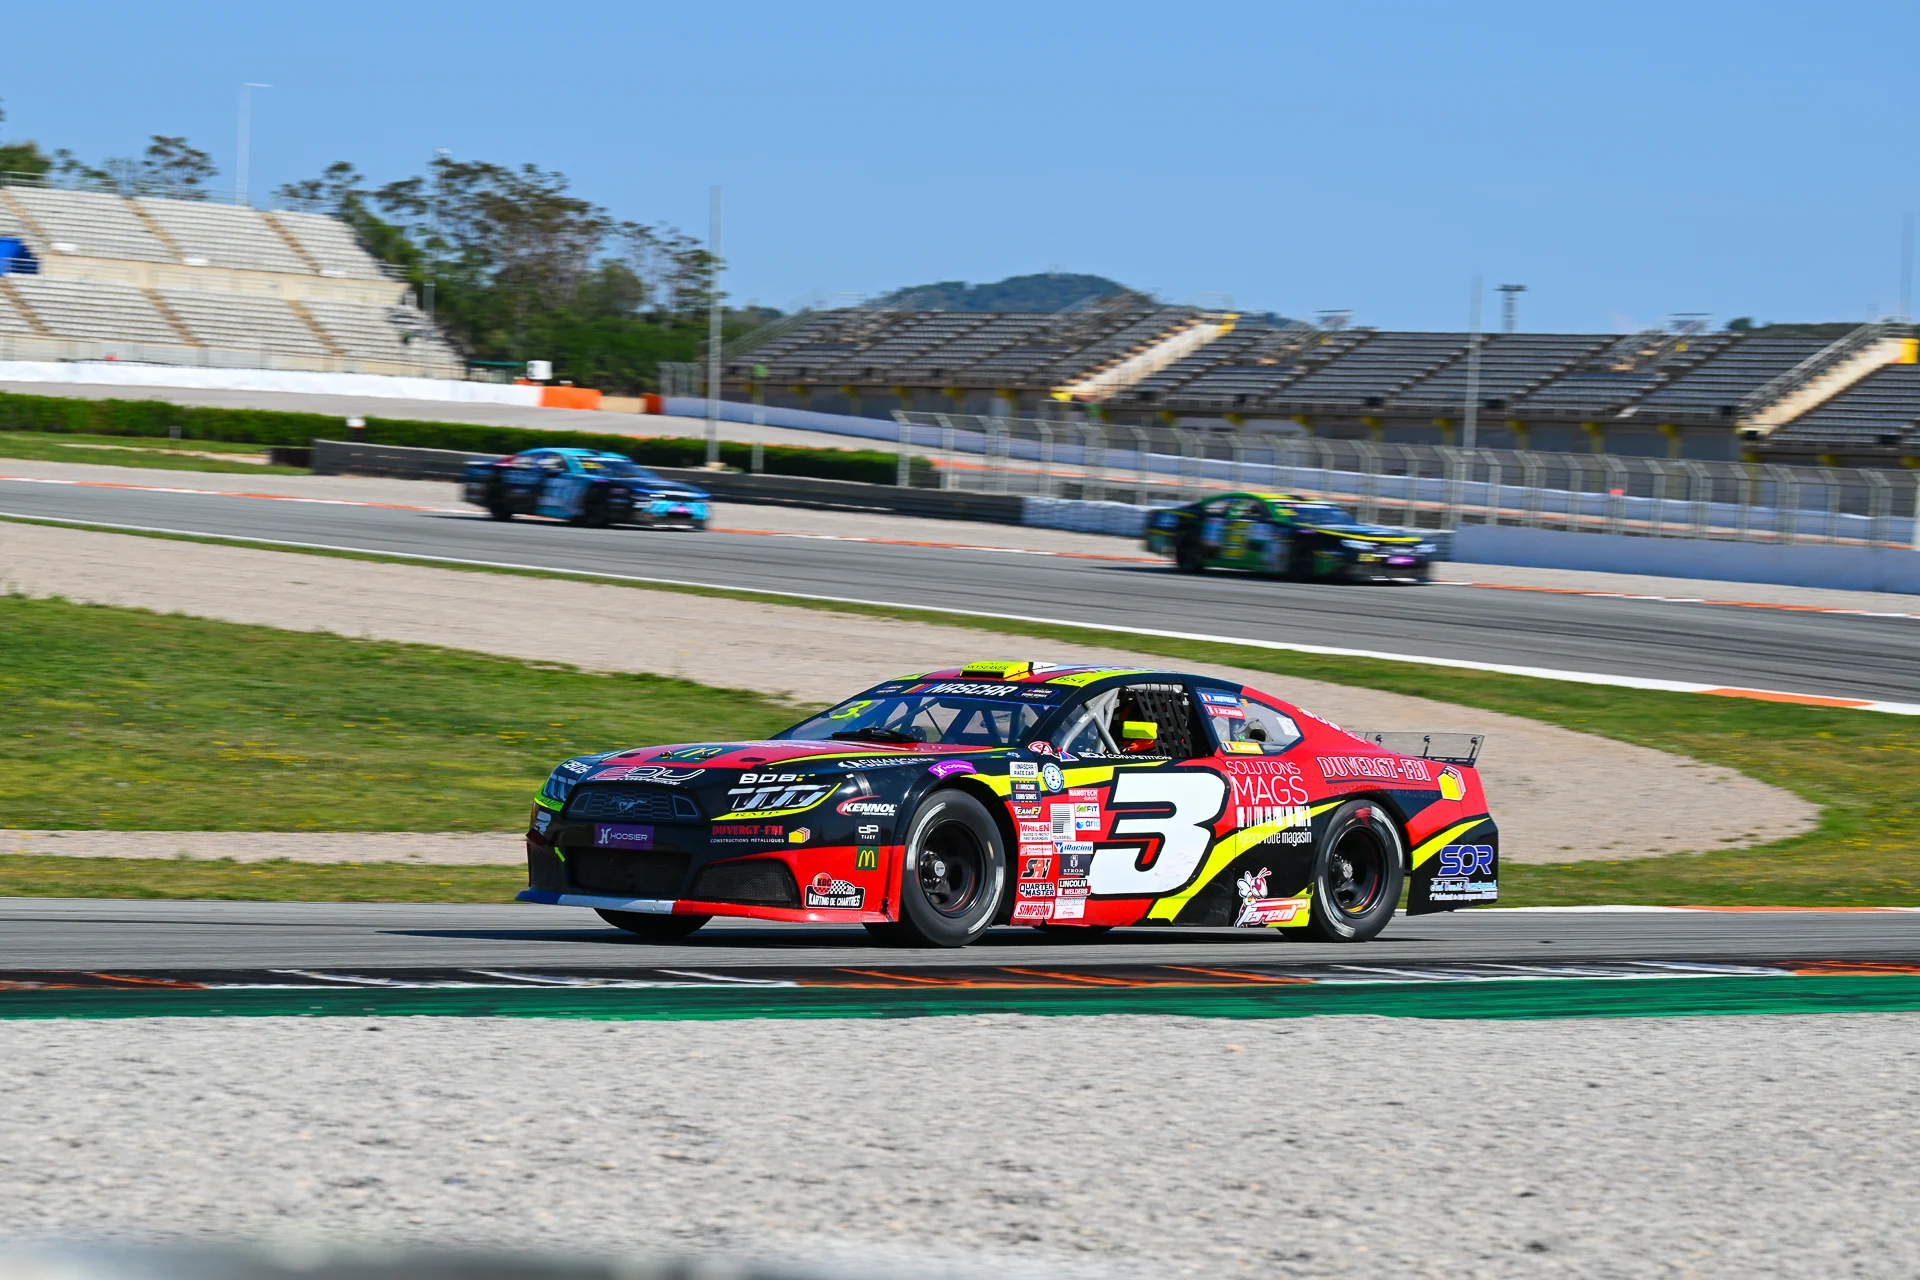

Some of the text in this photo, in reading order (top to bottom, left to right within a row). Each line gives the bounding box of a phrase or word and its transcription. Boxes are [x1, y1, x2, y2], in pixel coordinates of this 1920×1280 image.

[924, 683, 1019, 696] NASCAR
[831, 700, 872, 719] 3
[1225, 761, 1301, 775] SOLUTIONS
[1316, 757, 1431, 781] DUVERGT-FBI
[1069, 789, 1099, 797] NANOTECH
[1231, 776, 1309, 805] MAGS
[841, 803, 896, 812] KENNOL
[712, 825, 784, 835] DUVERGT-FBI
[1090, 772, 1226, 895] 3
[610, 832, 648, 842] HOOSIER
[1282, 828, 1312, 847] magasin
[1063, 844, 1092, 852] iRacing
[1438, 844, 1493, 876] SOR
[817, 878, 832, 887] KDC
[1020, 883, 1054, 893] QUARTER
[1059, 880, 1087, 888] LINCOLN
[808, 893, 860, 907] KARTING DE CHARTRES
[1018, 904, 1051, 916] SIMPSON
